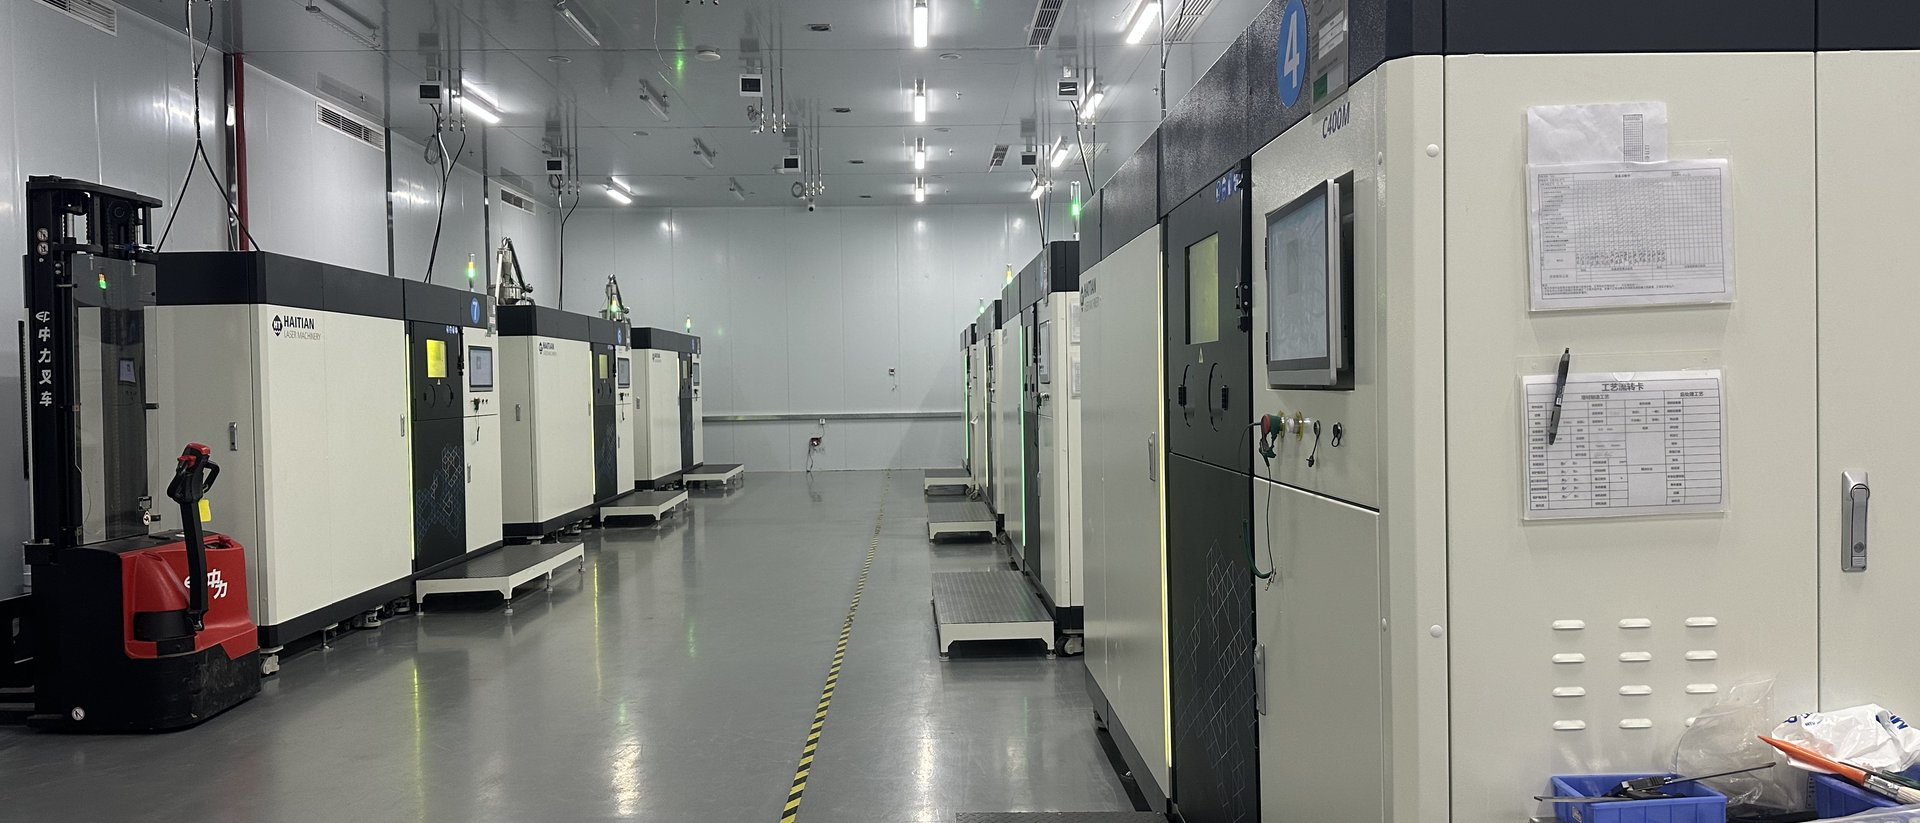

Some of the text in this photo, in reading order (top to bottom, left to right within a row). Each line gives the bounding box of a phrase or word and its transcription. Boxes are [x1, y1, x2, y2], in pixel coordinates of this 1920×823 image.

[1283, 10, 1300, 89] 4
[1322, 101, 1351, 139] C400M
[283, 315, 315, 330] HAITIAN
[472, 300, 478, 321] 7
[37, 326, 53, 407] 中力叉车
[1601, 382, 1644, 392] 工艺流转卡
[207, 568, 228, 600] 中力
